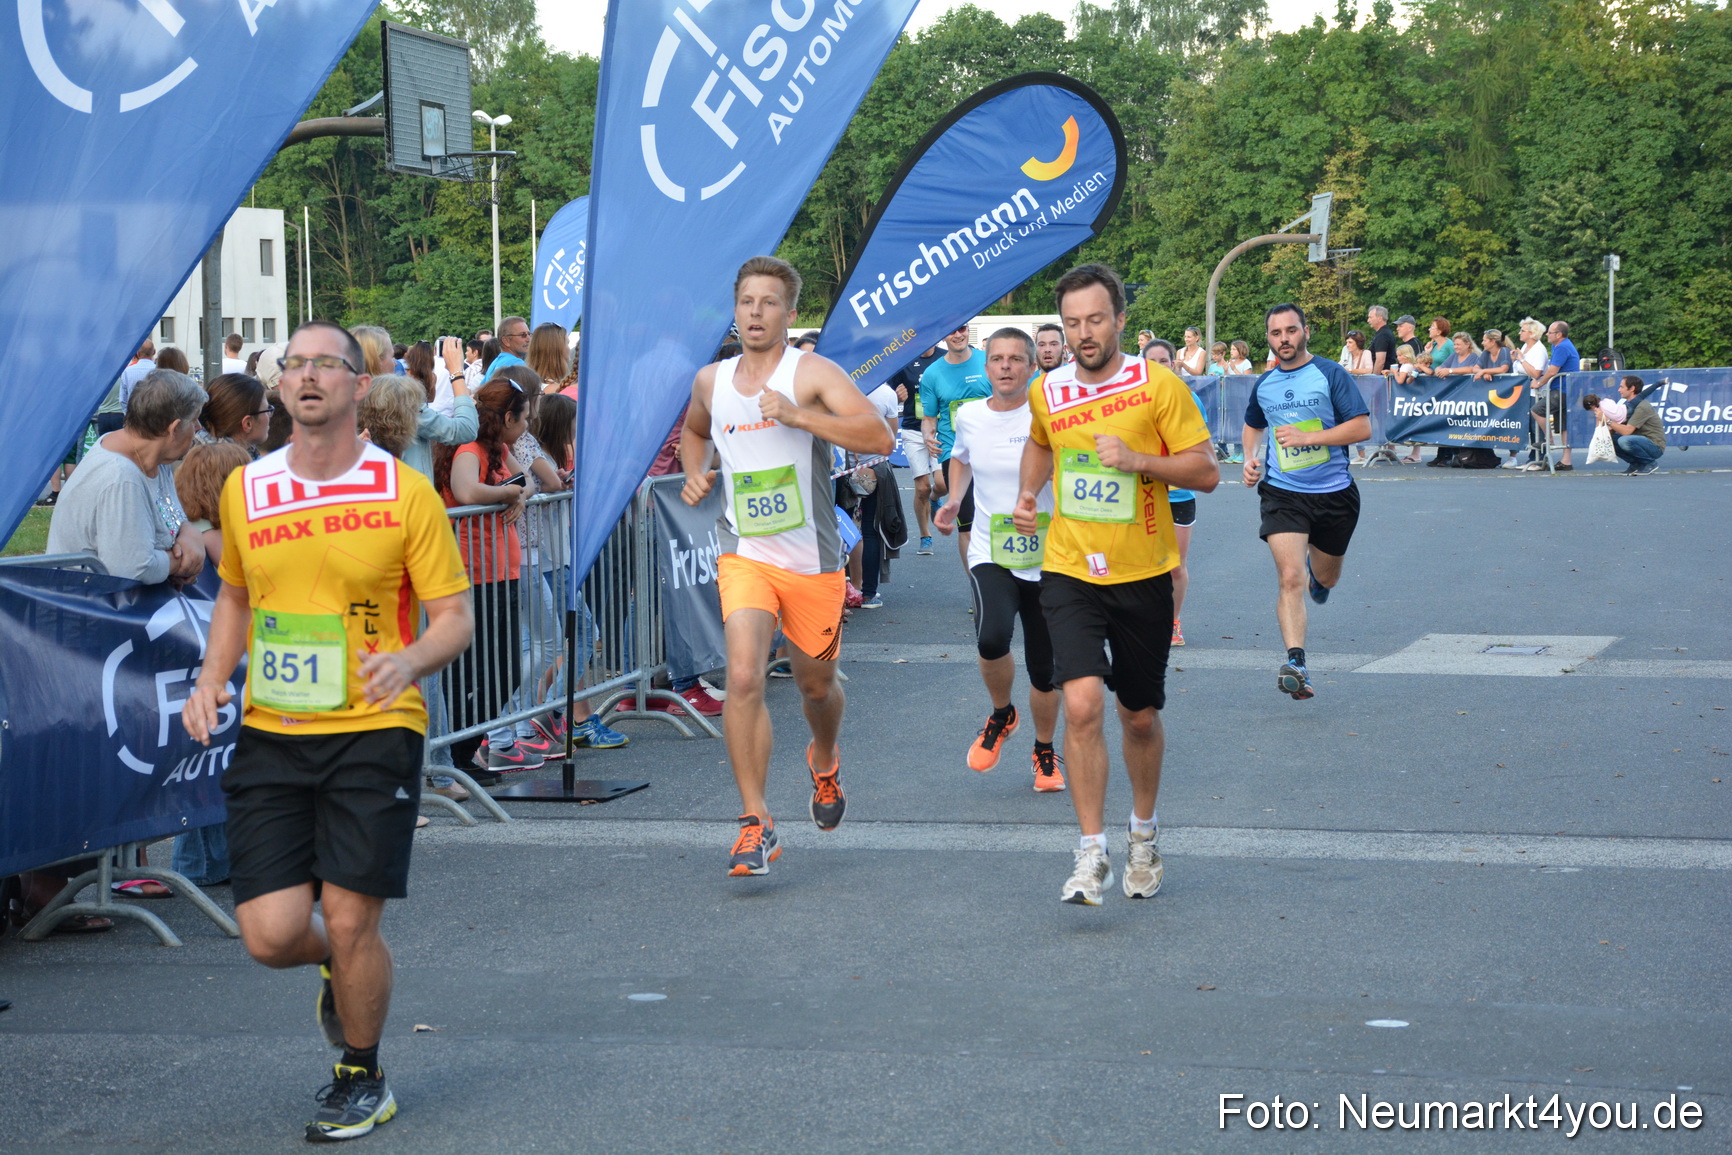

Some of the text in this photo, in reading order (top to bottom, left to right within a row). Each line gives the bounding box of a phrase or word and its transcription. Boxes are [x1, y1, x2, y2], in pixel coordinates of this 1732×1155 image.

[767, 0, 864, 146] AUTOM
[972, 171, 1108, 270] Druck und Medien
[848, 187, 1040, 328] Frischmann
[850, 327, 917, 382] mann-net.de
[1050, 390, 1152, 434] MAX BÖGL
[1283, 411, 1299, 419] TEAM
[1393, 396, 1489, 417] Frischmann
[1651, 399, 1732, 423] ische
[737, 419, 778, 432] KLEBL
[1447, 417, 1522, 429] Druck und Medien
[1664, 424, 1732, 435] UTOMOBIL
[1448, 432, 1520, 444] www.frischmann-net.de
[1073, 478, 1121, 504] 842
[747, 492, 788, 519] 588
[249, 507, 402, 551] MAX BÖGL
[1002, 534, 1040, 554] 438
[262, 650, 318, 684] 851
